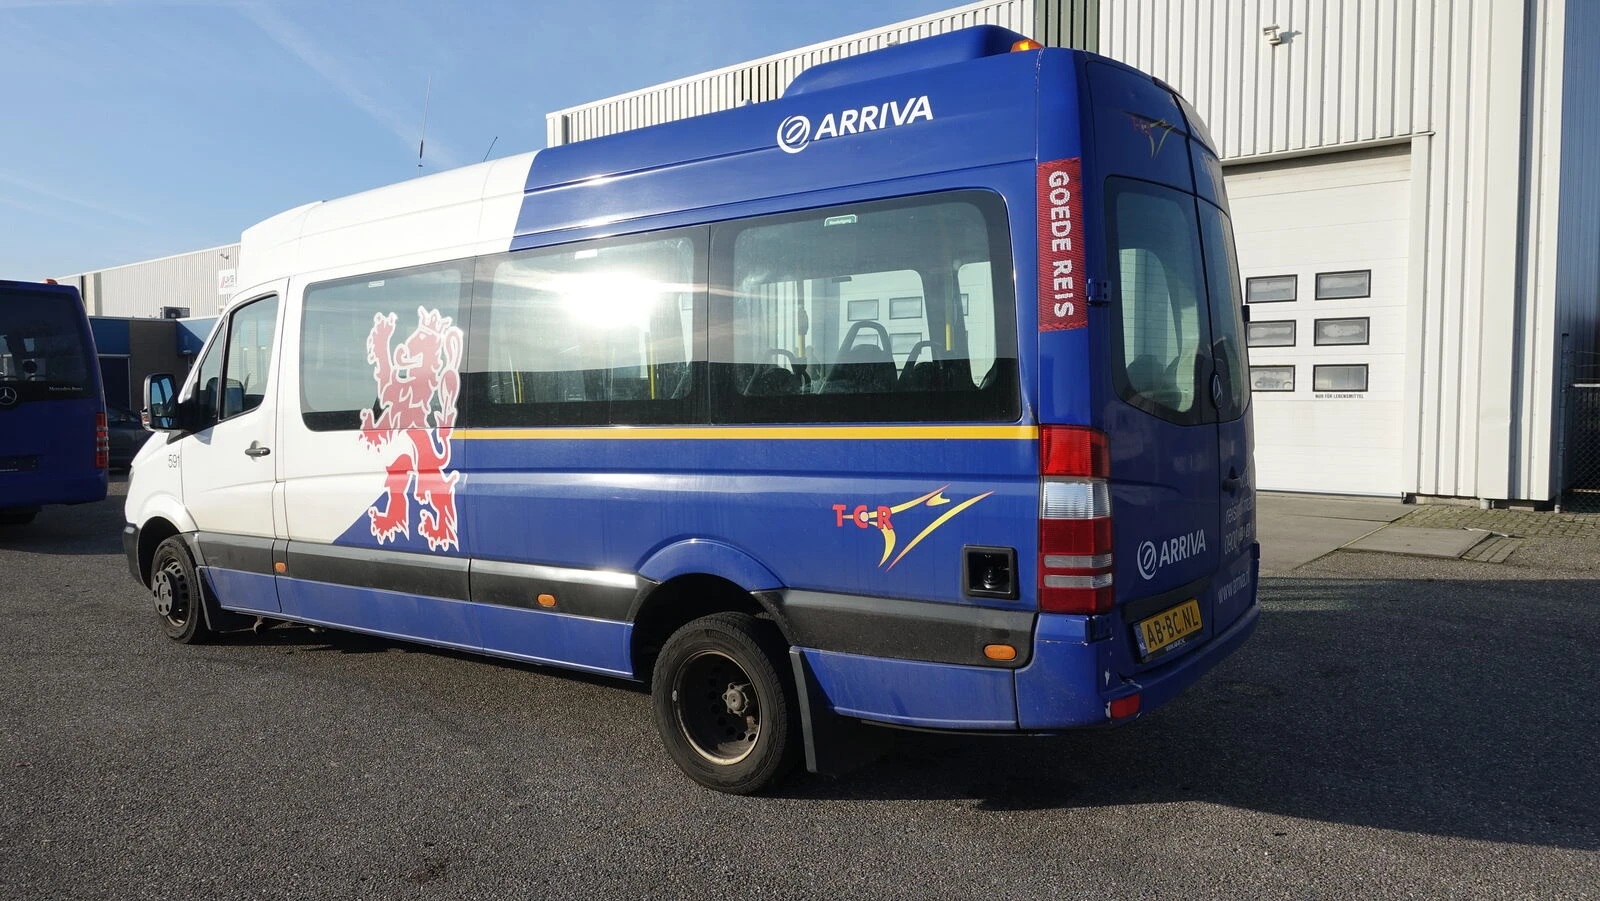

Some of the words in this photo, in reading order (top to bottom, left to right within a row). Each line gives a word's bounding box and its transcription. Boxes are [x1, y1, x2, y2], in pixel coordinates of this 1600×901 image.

[813, 95, 934, 141] ARRIVA
[1048, 170, 1072, 252] GOEDE
[1052, 259, 1074, 318] REIS
[1158, 528, 1206, 568] ARRIVA
